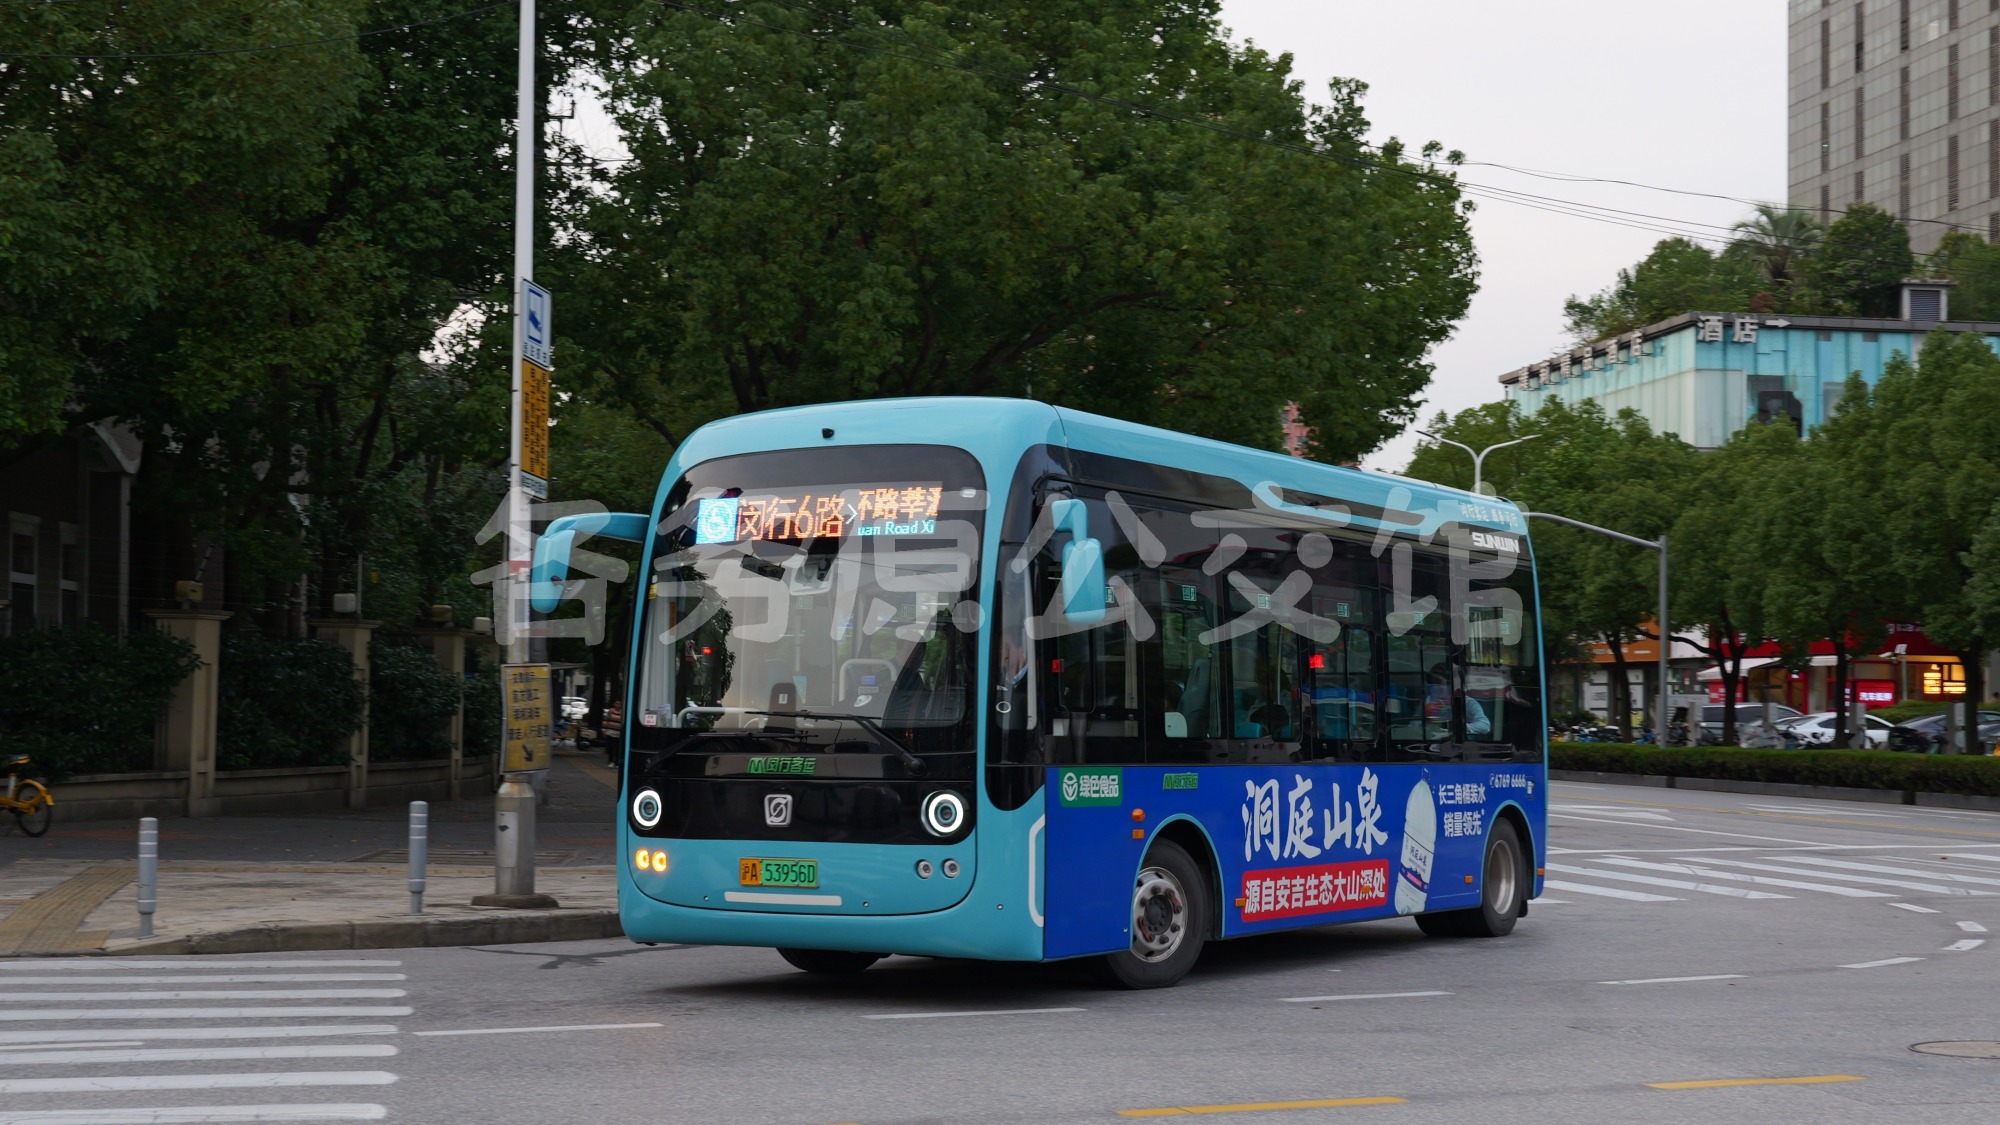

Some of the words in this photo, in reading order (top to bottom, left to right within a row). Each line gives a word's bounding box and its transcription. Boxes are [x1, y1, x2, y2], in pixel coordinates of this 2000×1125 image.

[1696, 315, 1759, 343] 酒店
[736, 494, 845, 542] 闵行6路
[885, 520, 919, 535] Road
[1471, 531, 1521, 553] SUNWIN
[1511, 773, 1527, 788] 6666
[1438, 783, 1486, 806] 长三角桶装水
[1241, 766, 1389, 863] 洞庭山泉
[1443, 811, 1482, 838] 销量领先
[741, 863, 758, 881] 沪A
[765, 863, 815, 883] 53956D
[1244, 867, 1387, 914] 源自安吉生态大山深处
